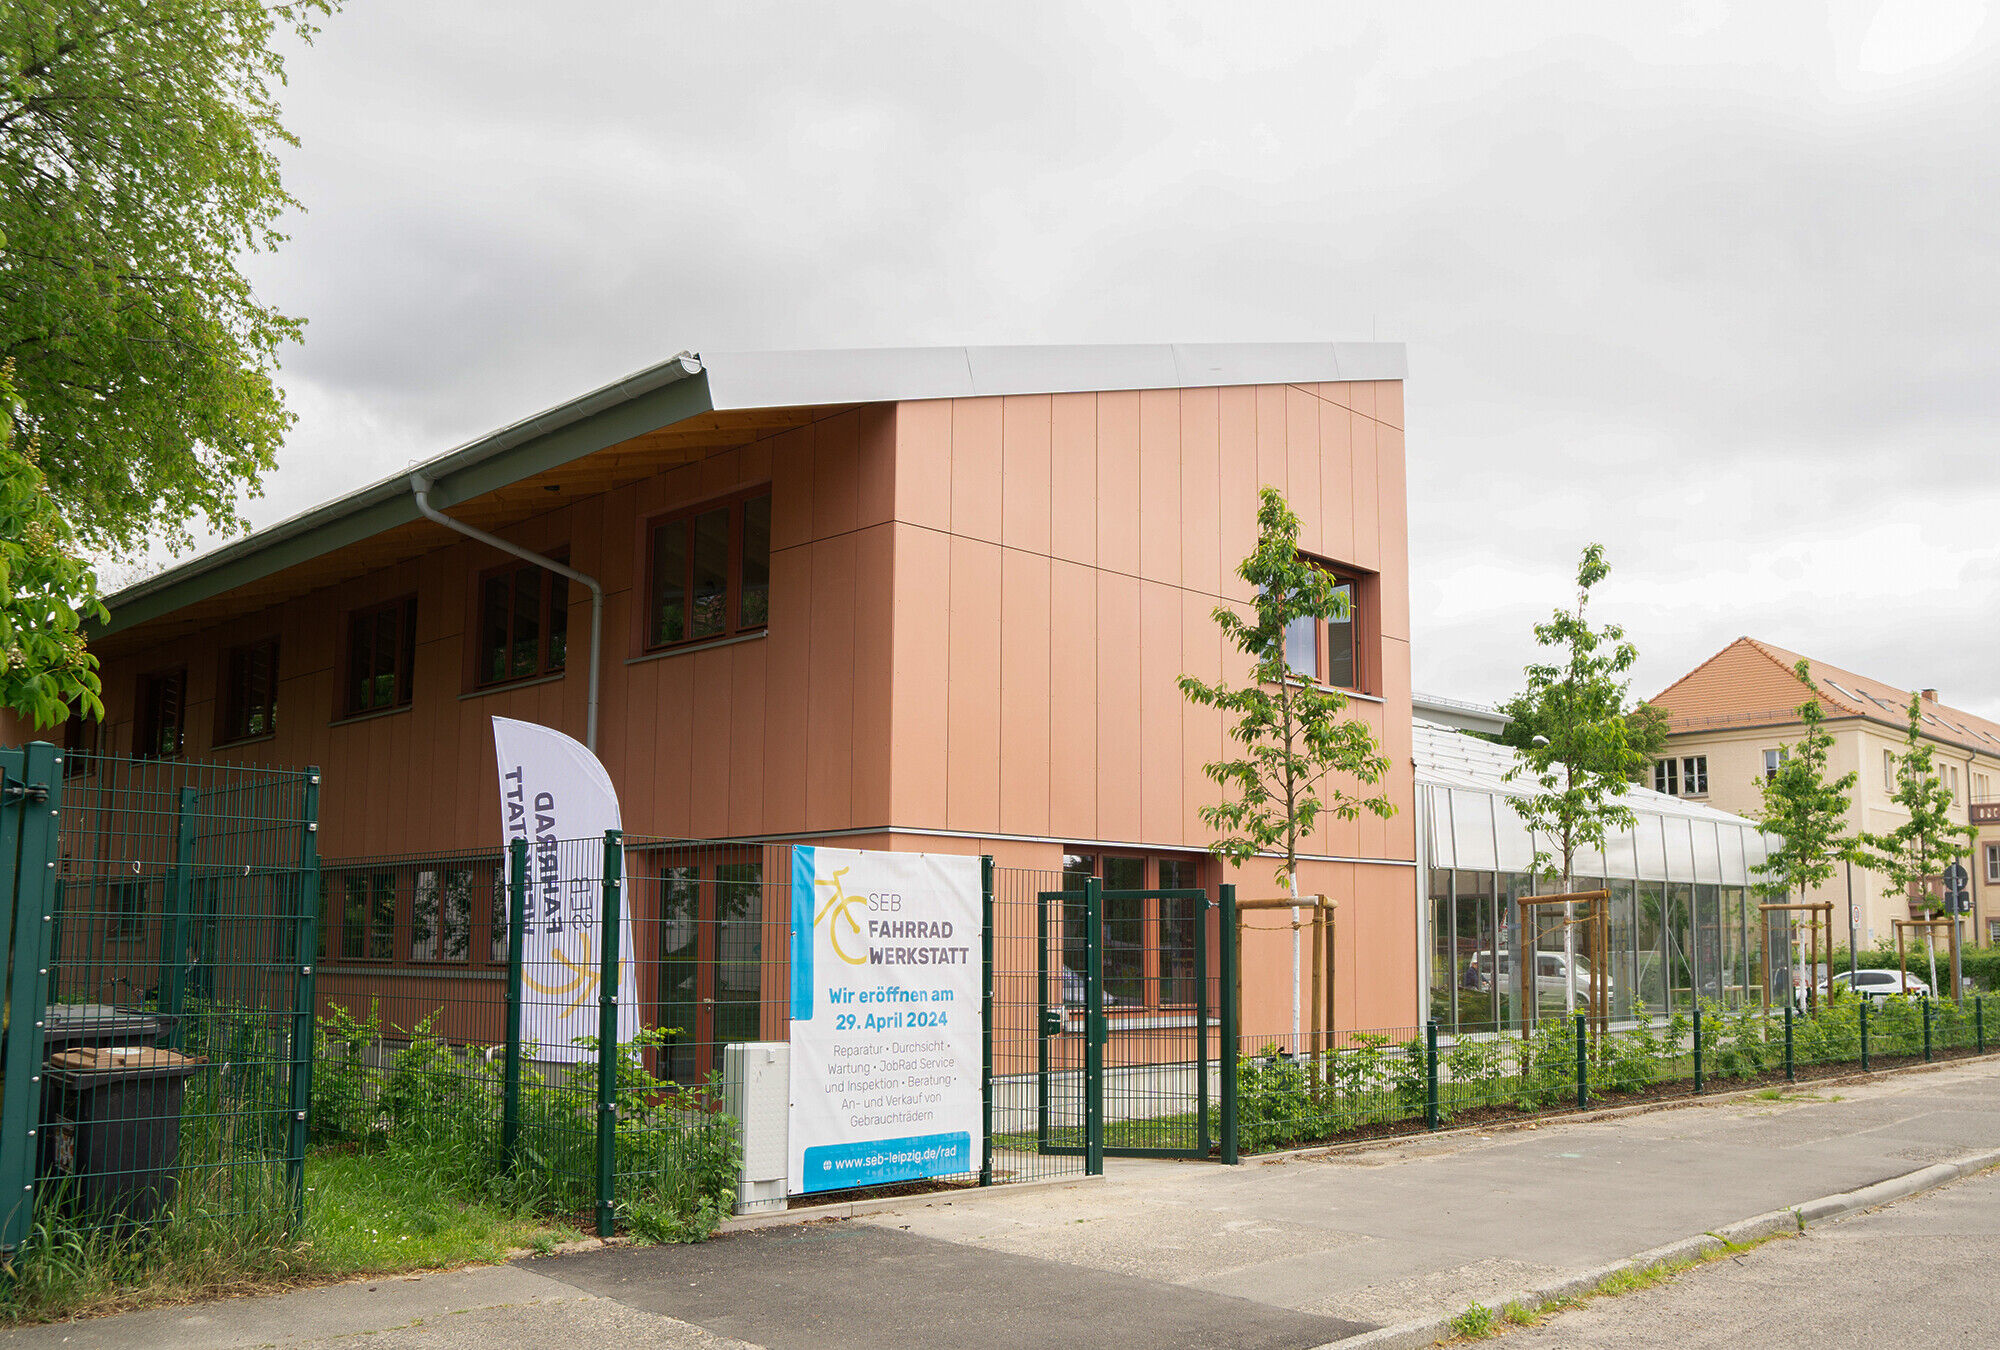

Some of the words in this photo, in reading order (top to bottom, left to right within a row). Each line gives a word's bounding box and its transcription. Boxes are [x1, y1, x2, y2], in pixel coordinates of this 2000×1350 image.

[868, 892, 902, 912] SEB
[868, 920, 954, 939] FAHRRAD
[869, 946, 970, 965] WERKSTATT
[829, 987, 855, 1004] Wir
[859, 986, 928, 1003] eröffnen
[931, 989, 954, 1002] am
[836, 1013, 861, 1030] 29.
[864, 1011, 903, 1033] April
[906, 1011, 948, 1028] 2024
[834, 1044, 883, 1058] Reparatur
[892, 1040, 944, 1054] Durchsicht
[827, 1063, 871, 1076] Wartung
[879, 1058, 917, 1072] JobRad
[920, 1057, 954, 1069] Service
[825, 1080, 844, 1093] und
[847, 1077, 899, 1093] Inspektion
[908, 1074, 951, 1088] Beratung
[842, 1098, 860, 1110] An-
[864, 1096, 883, 1108] und
[885, 1092, 922, 1106] Verkauf
[924, 1093, 942, 1103] von
[835, 1145, 957, 1170] www.seb-leipzig.de/rad
